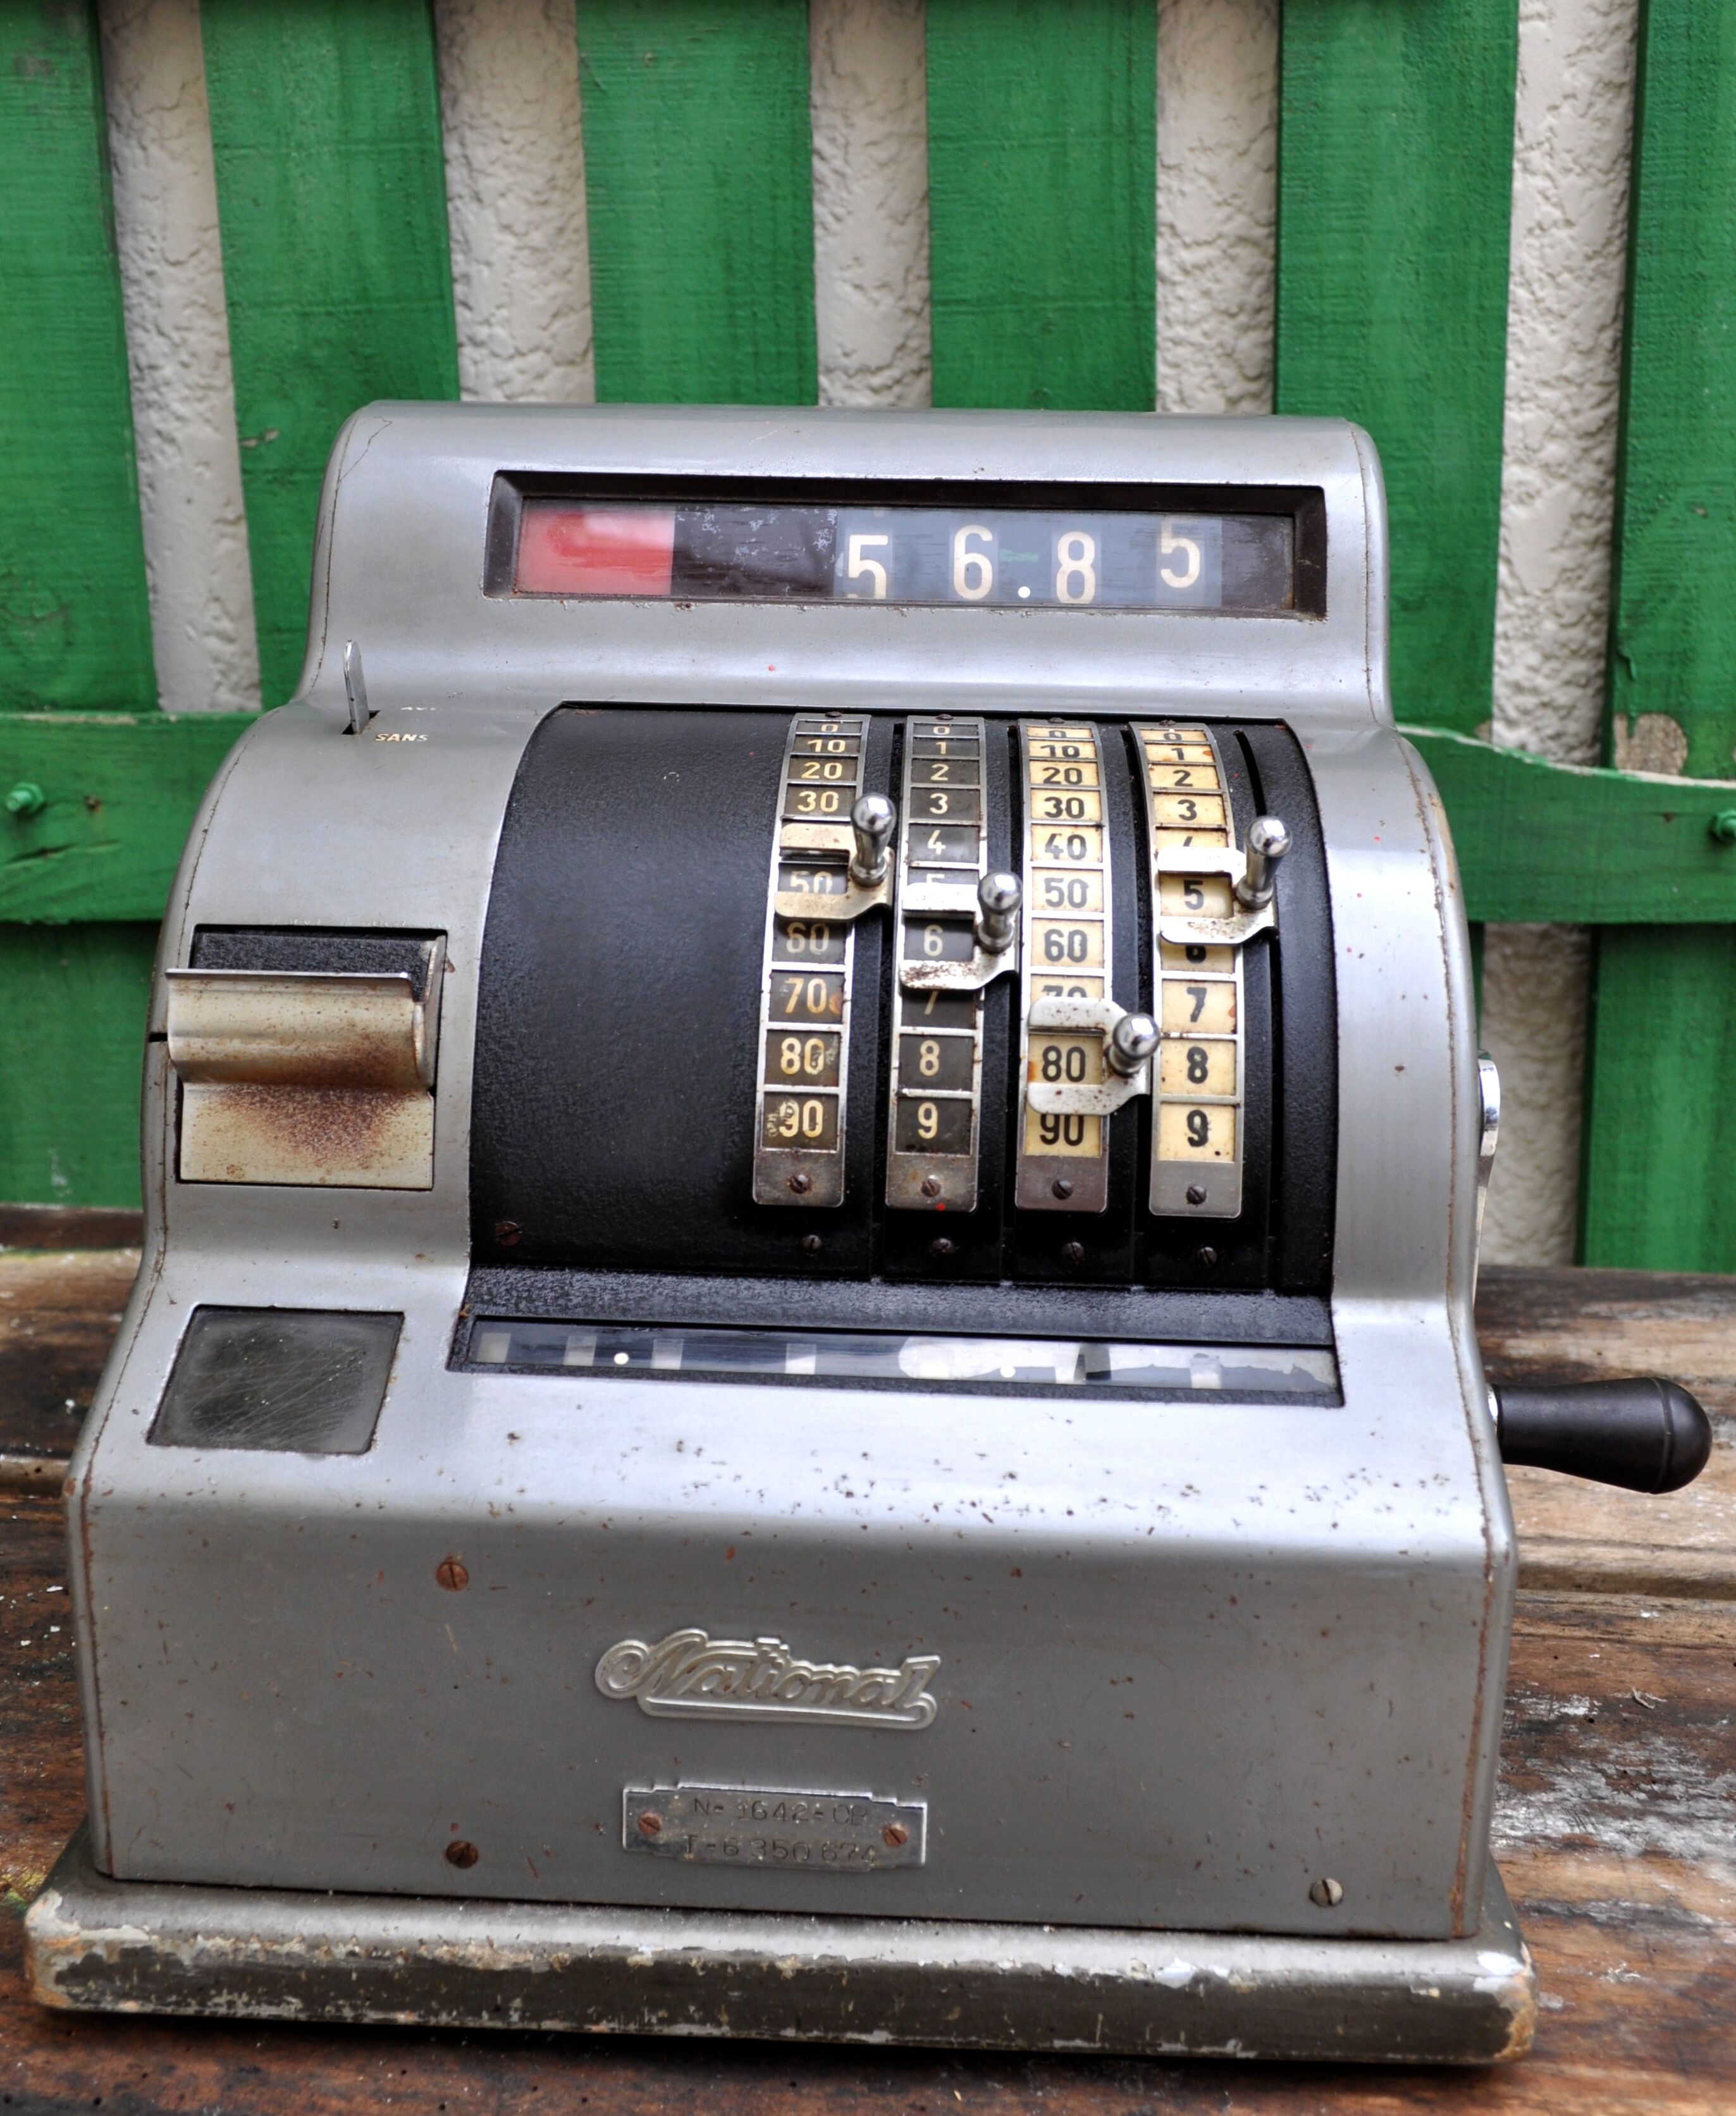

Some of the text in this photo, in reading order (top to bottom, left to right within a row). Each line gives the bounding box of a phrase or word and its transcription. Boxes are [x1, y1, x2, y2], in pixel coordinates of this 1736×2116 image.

[375, 733, 428, 741] SANS
[822, 724, 838, 733] 0
[933, 726, 950, 734] 0
[807, 739, 846, 753] 10
[935, 741, 946, 755] 1
[1040, 745, 1080, 758] 10
[1171, 747, 1185, 760] 1
[801, 762, 842, 780] 20
[930, 764, 949, 781] 2
[1042, 767, 1083, 785] 20
[1173, 769, 1193, 787] 2
[797, 791, 839, 812] 30
[930, 793, 948, 814] 3
[1044, 796, 1085, 819] 30
[1178, 799, 1197, 820] 3
[928, 829, 946, 855] 4
[1045, 833, 1087, 860] 40
[1043, 877, 1089, 908] 50
[1183, 879, 1205, 910] 5
[786, 922, 829, 955] 60
[923, 924, 943, 956] 6
[1044, 929, 1088, 963] 60
[785, 977, 827, 1013] 70
[1186, 986, 1207, 1023] 7
[780, 1037, 825, 1075] 80
[920, 1040, 940, 1076] 8
[1042, 1046, 1086, 1082] 80
[1186, 1046, 1208, 1084] 8
[779, 1099, 823, 1137] 90
[918, 1102, 938, 1139] 9
[1040, 1115, 1084, 1146] 90
[1186, 1109, 1209, 1147] 9
[595, 1628, 941, 1729] National
